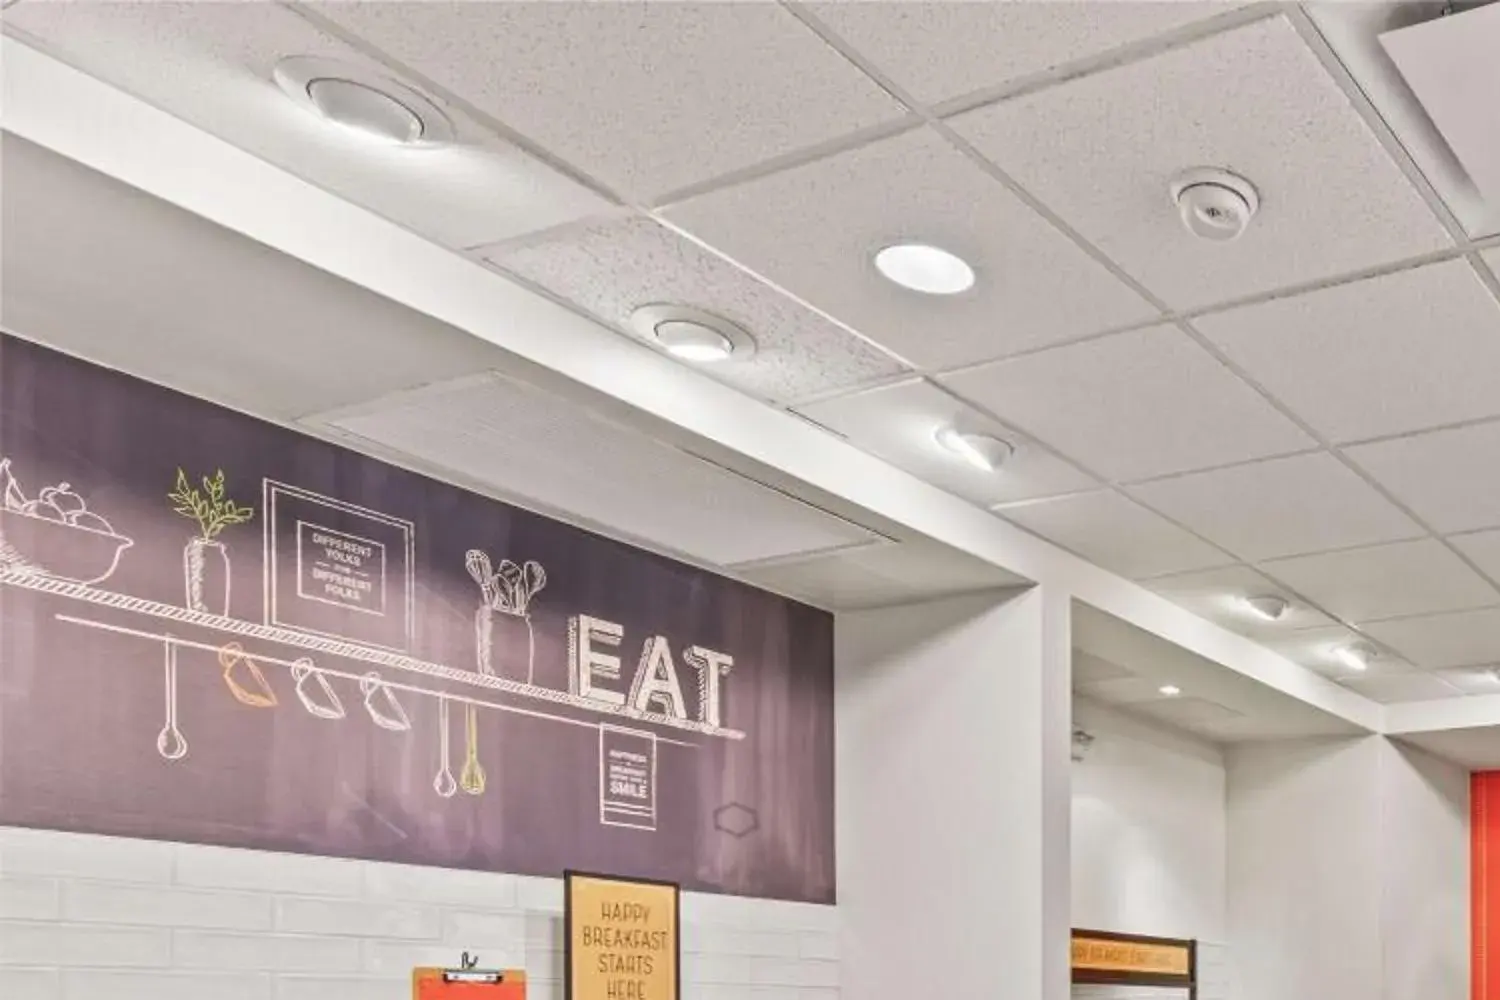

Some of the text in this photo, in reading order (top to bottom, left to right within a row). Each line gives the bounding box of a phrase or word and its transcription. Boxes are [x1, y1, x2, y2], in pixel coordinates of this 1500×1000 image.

[312, 532, 372, 558] DIFFERENT
[325, 547, 361, 567] YOLKS
[312, 566, 372, 593] DIFFERENT
[568, 614, 734, 728] EAT
[610, 780, 647, 799] SMILE
[601, 901, 651, 923] HAPPY
[583, 925, 668, 951] BREAKFAST
[599, 953, 654, 975] STARTS
[607, 978, 646, 1000] HERE
